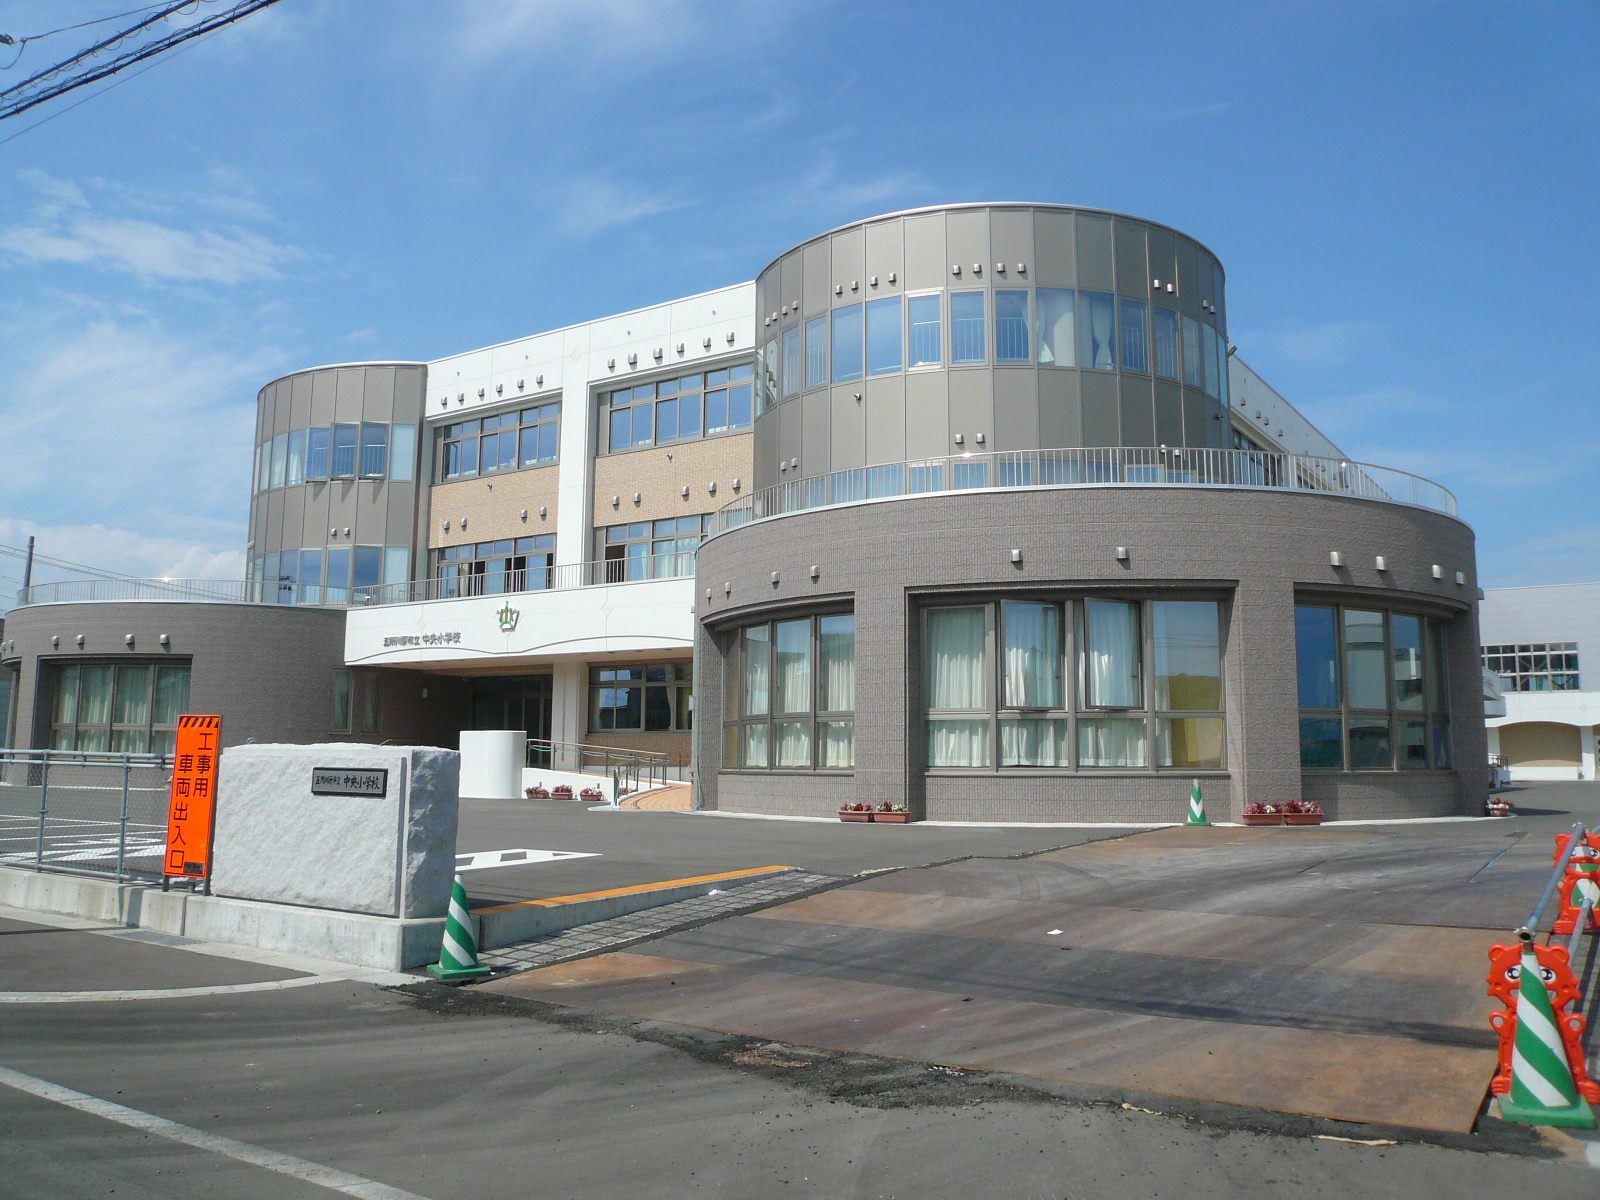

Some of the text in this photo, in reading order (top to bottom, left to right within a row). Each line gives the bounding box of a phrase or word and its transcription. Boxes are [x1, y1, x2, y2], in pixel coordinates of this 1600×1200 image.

[422, 631, 461, 646] 中央小学校
[193, 733, 213, 797] 工事用
[343, 774, 381, 790] 中央小学校
[170, 754, 194, 868] 車両出入口
